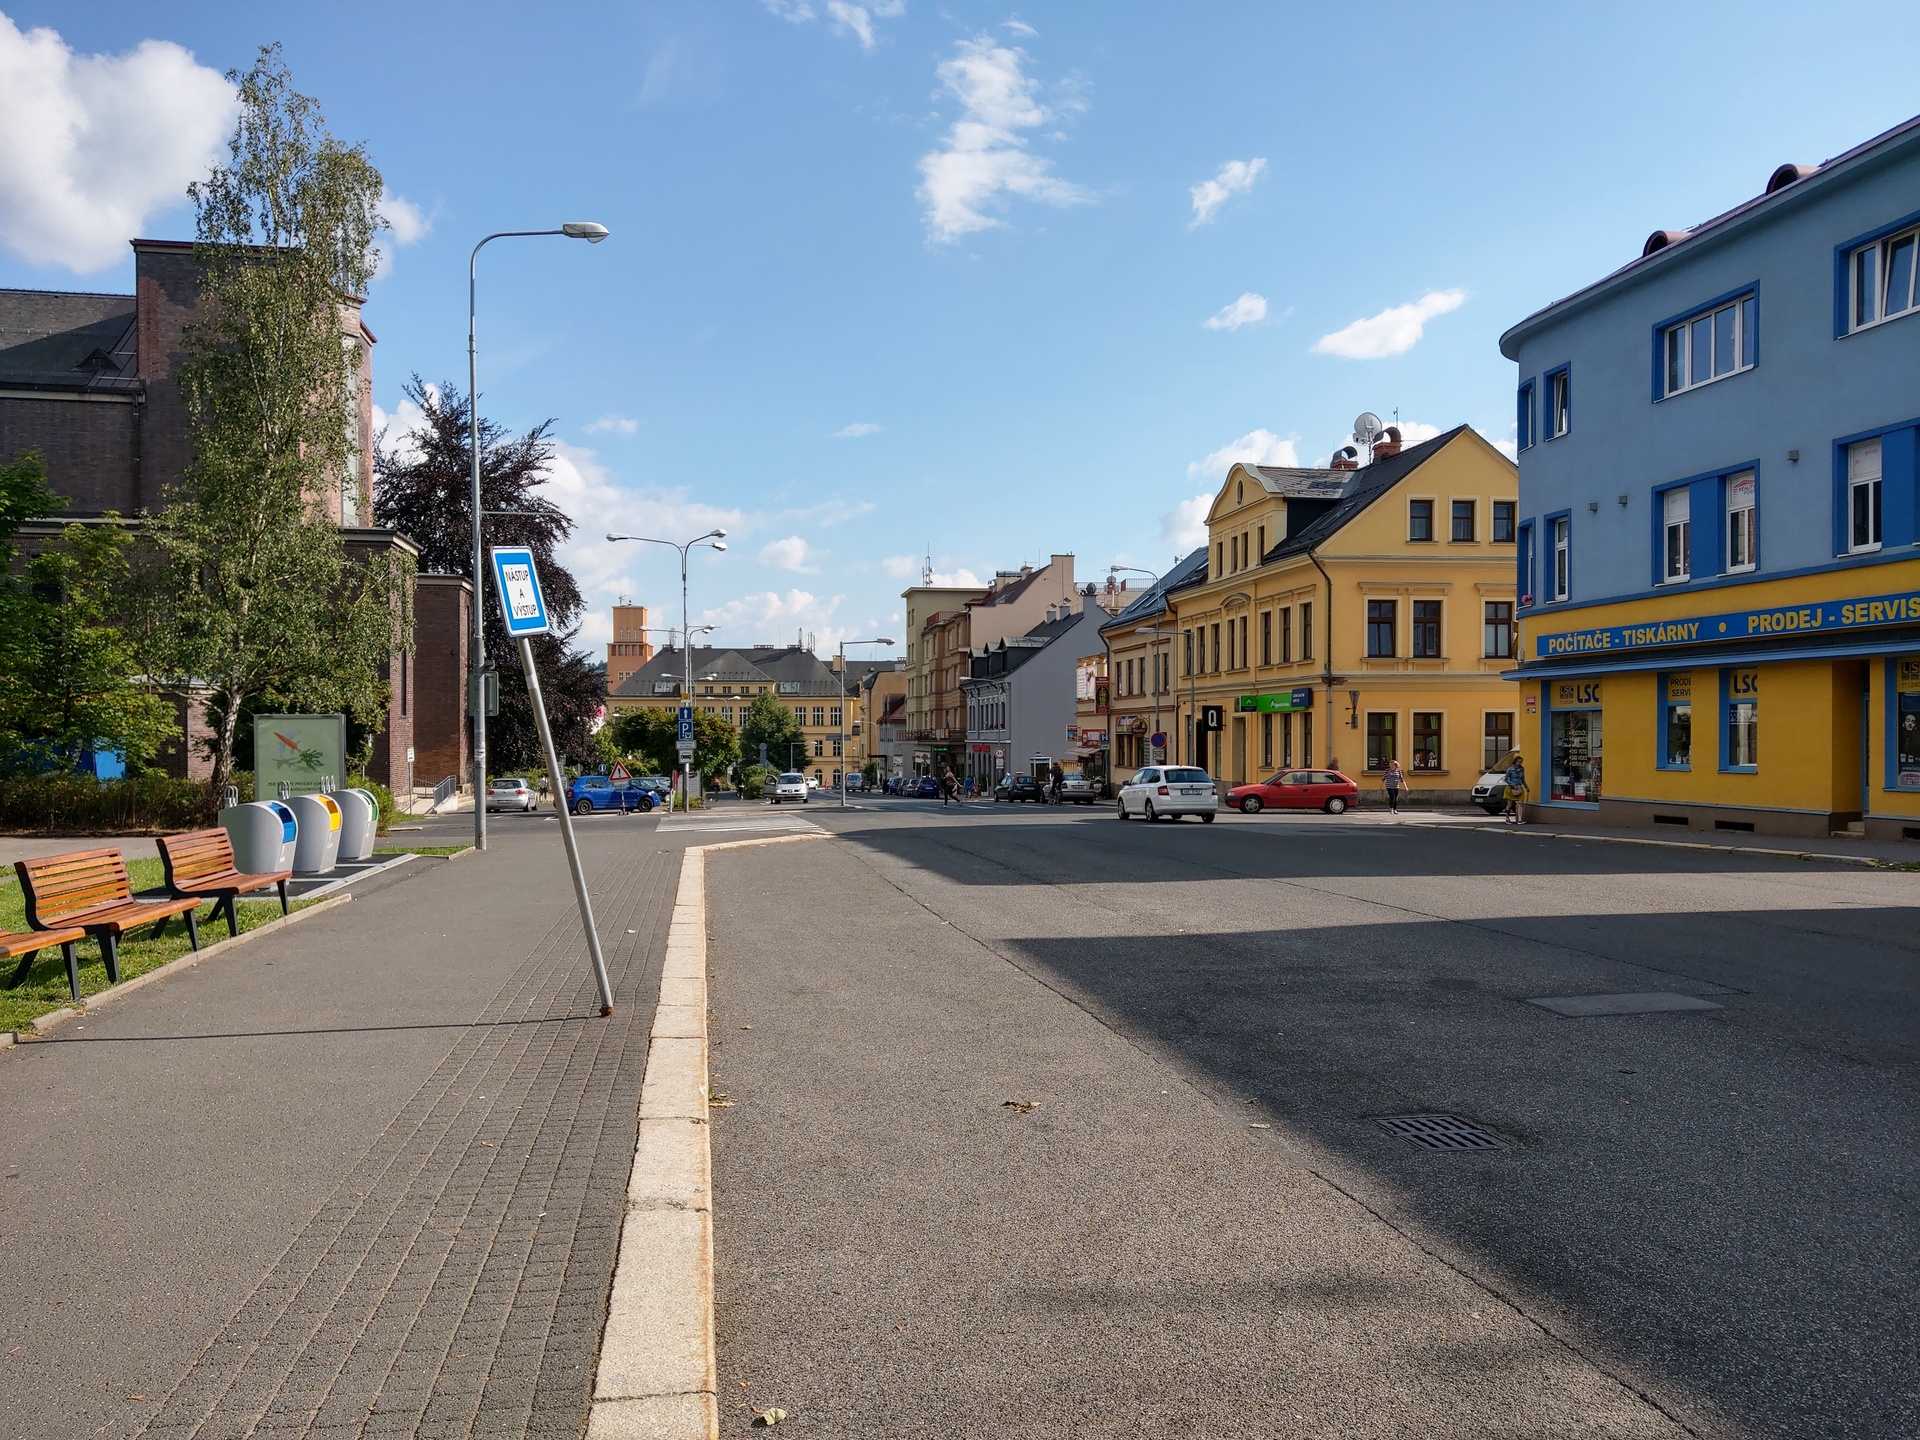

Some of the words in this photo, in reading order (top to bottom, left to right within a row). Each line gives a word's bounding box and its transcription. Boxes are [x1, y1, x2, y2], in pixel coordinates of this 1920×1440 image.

[505, 568, 528, 581] NÁSTUP
[520, 588, 525, 598] A
[513, 603, 536, 616] VÝSTUP
[1748, 608, 1823, 634] PRODEJ
[1841, 597, 1920, 624] SERVIS
[1548, 627, 1611, 653] POČÍTAČE
[1623, 622, 1700, 646] TISKÁRNY
[1733, 674, 1758, 694] LSC
[1577, 683, 1599, 704] LSC
[1208, 710, 1217, 727] Q
